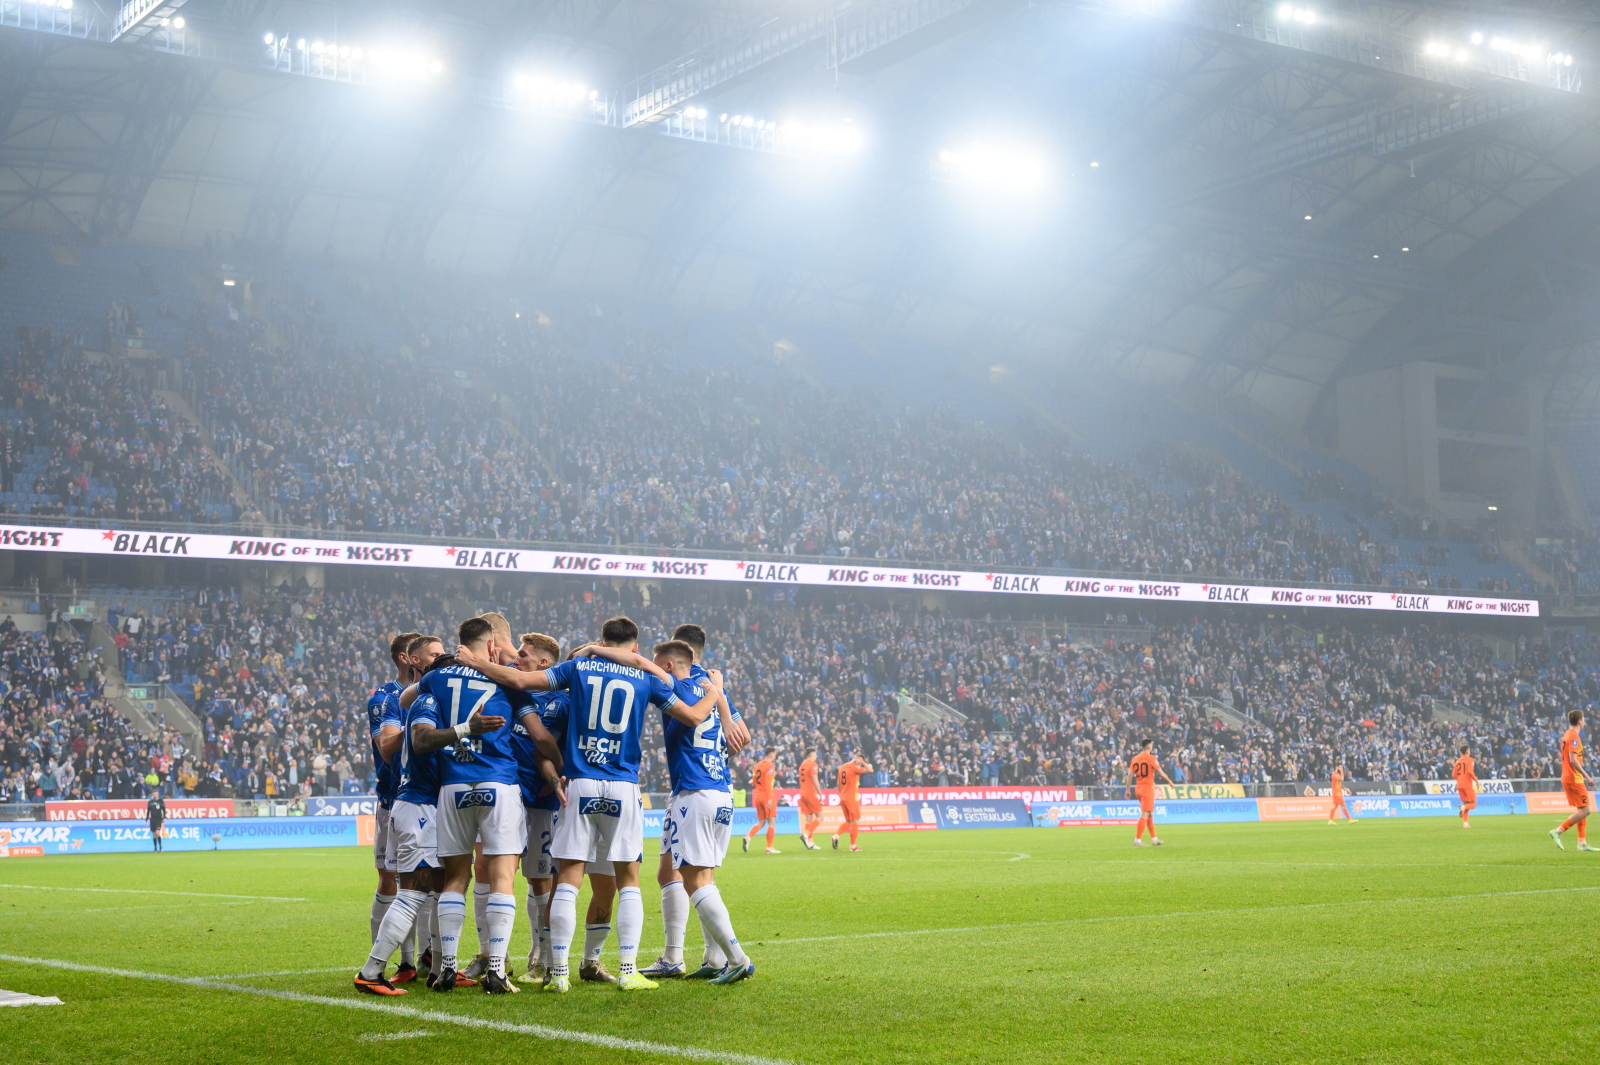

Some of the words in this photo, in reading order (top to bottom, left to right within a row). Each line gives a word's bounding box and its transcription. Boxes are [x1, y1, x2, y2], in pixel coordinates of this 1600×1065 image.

[113, 533, 191, 554] BLACK
[229, 540, 286, 557] KING
[291, 546, 310, 555] OF
[314, 547, 340, 557] THE
[347, 546, 413, 562] NIGHT
[454, 550, 520, 569] BLACK
[551, 556, 601, 571] KING
[605, 561, 623, 570] OF
[626, 563, 647, 571] THE
[652, 561, 708, 576] NIGHT
[744, 563, 800, 581] BLACK
[827, 569, 868, 582] KING
[872, 574, 886, 582] OF
[890, 575, 908, 583] THE
[912, 573, 961, 587] NIGHT
[992, 576, 1040, 592] BLACK
[1064, 580, 1100, 593] KING
[1118, 585, 1134, 593] THE
[1138, 583, 1181, 597] NIGHT
[1208, 587, 1250, 602] BLACK
[1271, 590, 1302, 602] KING
[1336, 593, 1373, 606] NIGHT
[1395, 595, 1429, 610] BLACK
[1446, 599, 1473, 611] KING
[1500, 602, 1531, 613] NIGHT
[447, 678, 497, 727] 17
[587, 676, 635, 734] 10
[578, 735, 621, 754] LECH
[585, 749, 609, 764] Pils
[1133, 762, 1148, 777] 20
[1456, 763, 1466, 775] 21
[841, 771, 847, 785] 8
[133, 807, 229, 819] WRKWEAR
[1048, 805, 1092, 819] OSKAR
[1105, 807, 1115, 816] TU
[1353, 799, 1390, 812] OSKAR
[964, 812, 1017, 822] EKSTRAKLASA
[94, 829, 111, 841] TU
[182, 827, 200, 841] SIĘ
[203, 825, 305, 837] NIEZAPOMNIANY
[309, 824, 347, 835] URLOP
